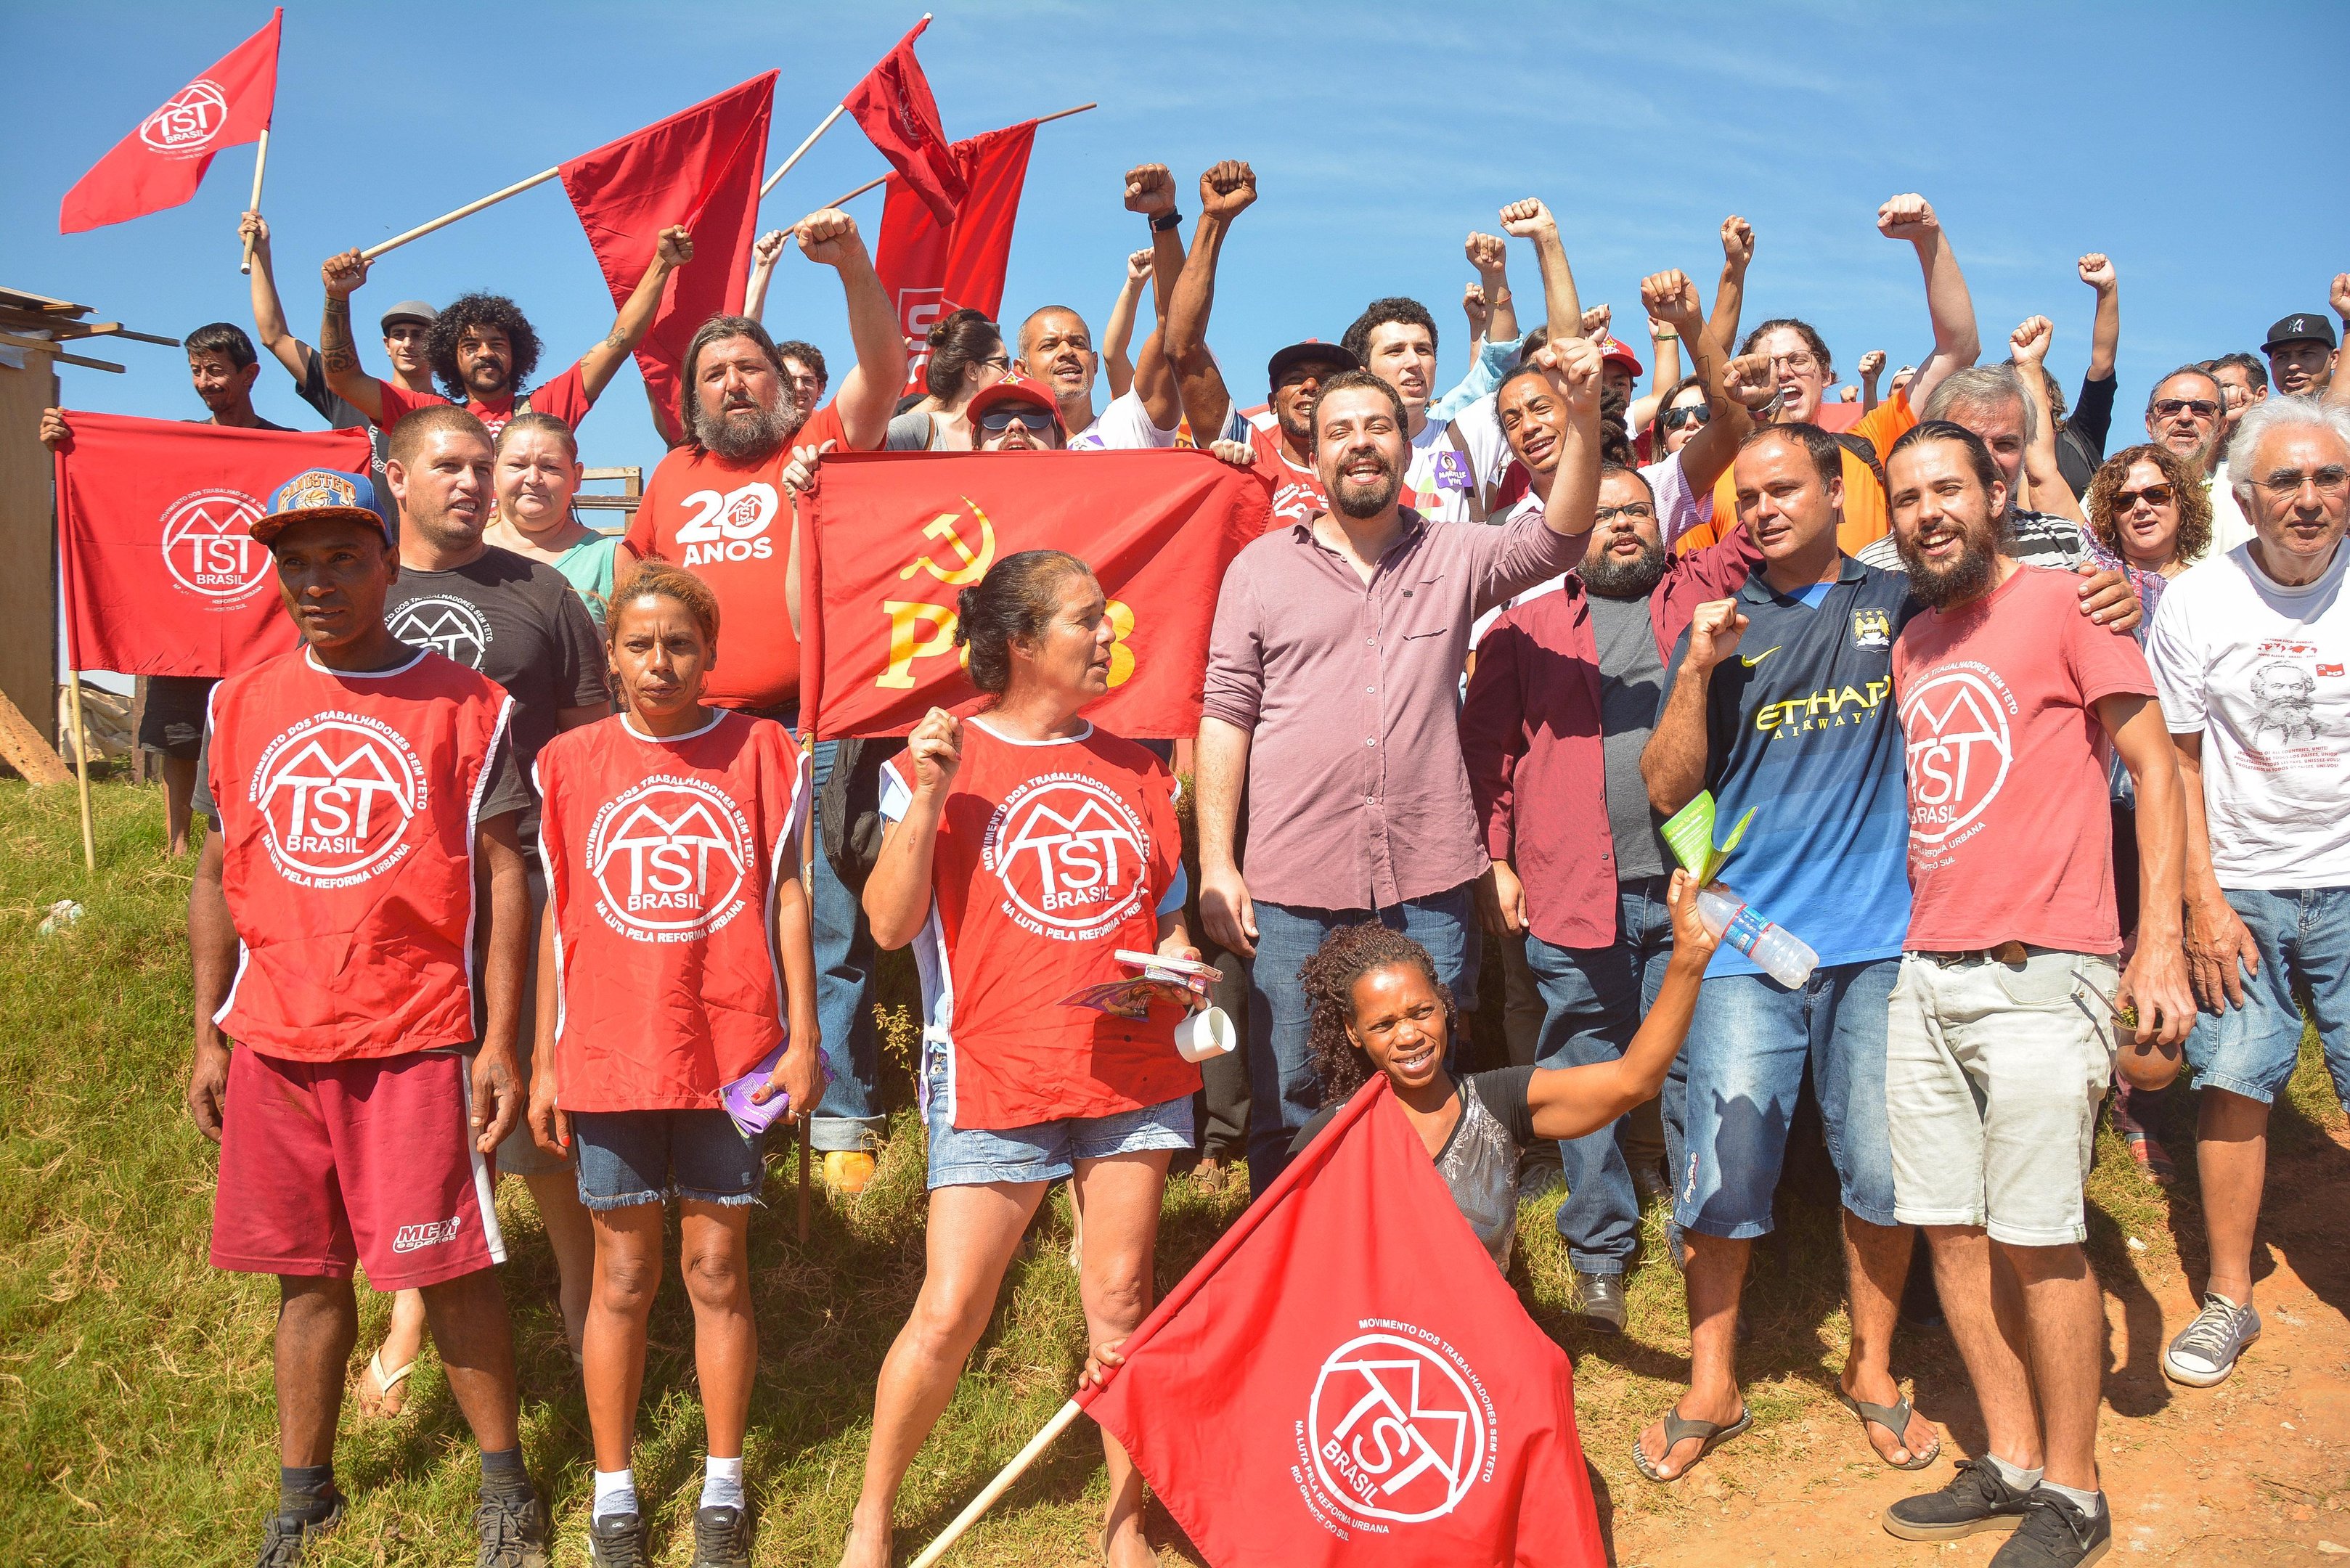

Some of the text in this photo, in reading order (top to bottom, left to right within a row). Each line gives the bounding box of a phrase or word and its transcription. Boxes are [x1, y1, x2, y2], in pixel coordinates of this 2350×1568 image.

[166, 129, 209, 143] BRASIL
[159, 496, 188, 523] MOVIMENTO
[187, 490, 202, 499] DOS
[203, 488, 256, 503] TRABALHADORES
[277, 472, 356, 513] GANGSTER
[675, 481, 778, 544] 20
[682, 536, 773, 568] ANOS
[196, 574, 246, 585] BRASIL
[212, 596, 241, 605] REFORMA
[394, 600, 410, 613] DOS
[473, 610, 487, 624] SEM
[482, 622, 494, 642] TETO
[1914, 672, 1930, 690] DOS
[1986, 670, 2006, 691] SEM
[2000, 687, 2019, 716] TETO
[1774, 709, 1876, 740] AIRWAYS
[248, 710, 428, 811] MOVIMENTO DOS TRABALHADORES SEM TETO
[585, 774, 755, 869] MOVIMENTO DOS TRABALHADORES SEM TETO
[982, 804, 1008, 871] MOVIMENTO
[1004, 784, 1028, 805] DOS
[1027, 772, 1123, 804] TRABALHADORES
[1122, 803, 1142, 827] SEM
[1949, 821, 1986, 849] URBANA
[261, 833, 412, 889] NA LUTA PELA REFORMA URBANA
[286, 835, 364, 854] BRASIL
[1939, 855, 1956, 867] SUL
[627, 892, 704, 912] BRASIL
[1001, 886, 1150, 942] NA LUTA PELA REFORMA URBA
[1042, 886, 1116, 911] BRASIL
[595, 899, 746, 943] NA LUTA PELA REFORMA URBANA
[396, 1220, 457, 1244] MCM
[396, 1235, 457, 1249] esportes
[1358, 1318, 1417, 1334] MOVIMENTO
[1418, 1328, 1441, 1345] DOS
[1442, 1341, 1498, 1426] TRABALHADORES
[1482, 1453, 1497, 1483] TETO
[1295, 1420, 1390, 1534] NA LUTA PELA REFORMA URBANA
[1321, 1438, 1382, 1508] BRASIL
[1290, 1464, 1350, 1542] RIO GRANDE DO SUL
